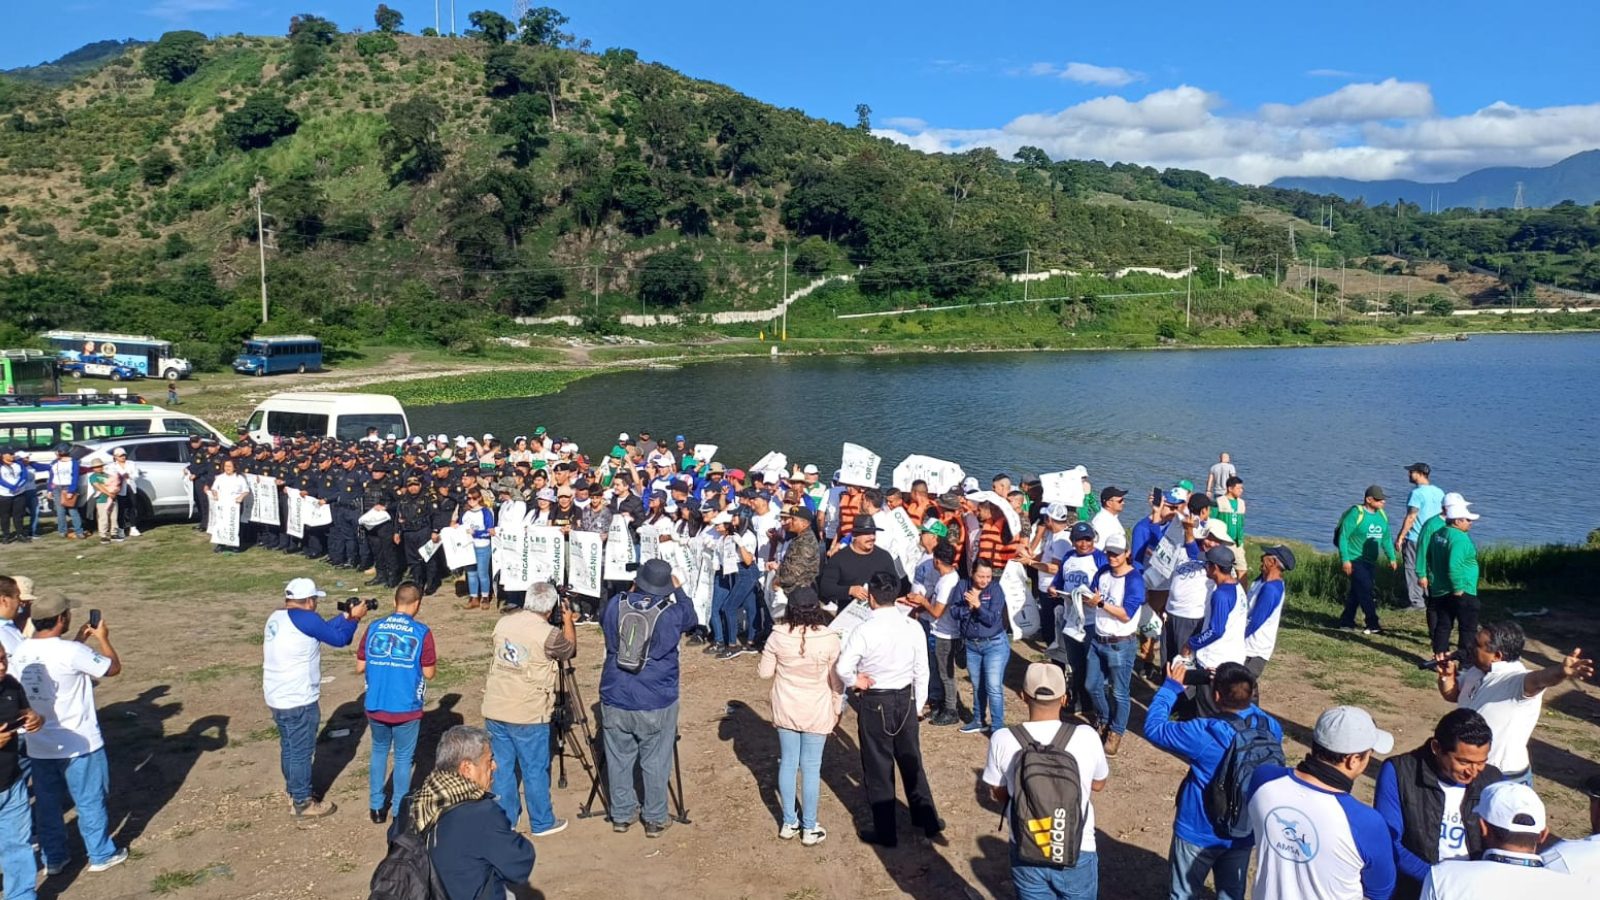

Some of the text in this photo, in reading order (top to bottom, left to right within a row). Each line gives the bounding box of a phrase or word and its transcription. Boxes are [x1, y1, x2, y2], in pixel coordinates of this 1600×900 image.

[386, 616, 410, 625] Radio
[378, 623, 414, 633] SONORA
[1050, 808, 1066, 863] adidas
[1276, 841, 1300, 857] AMSA
